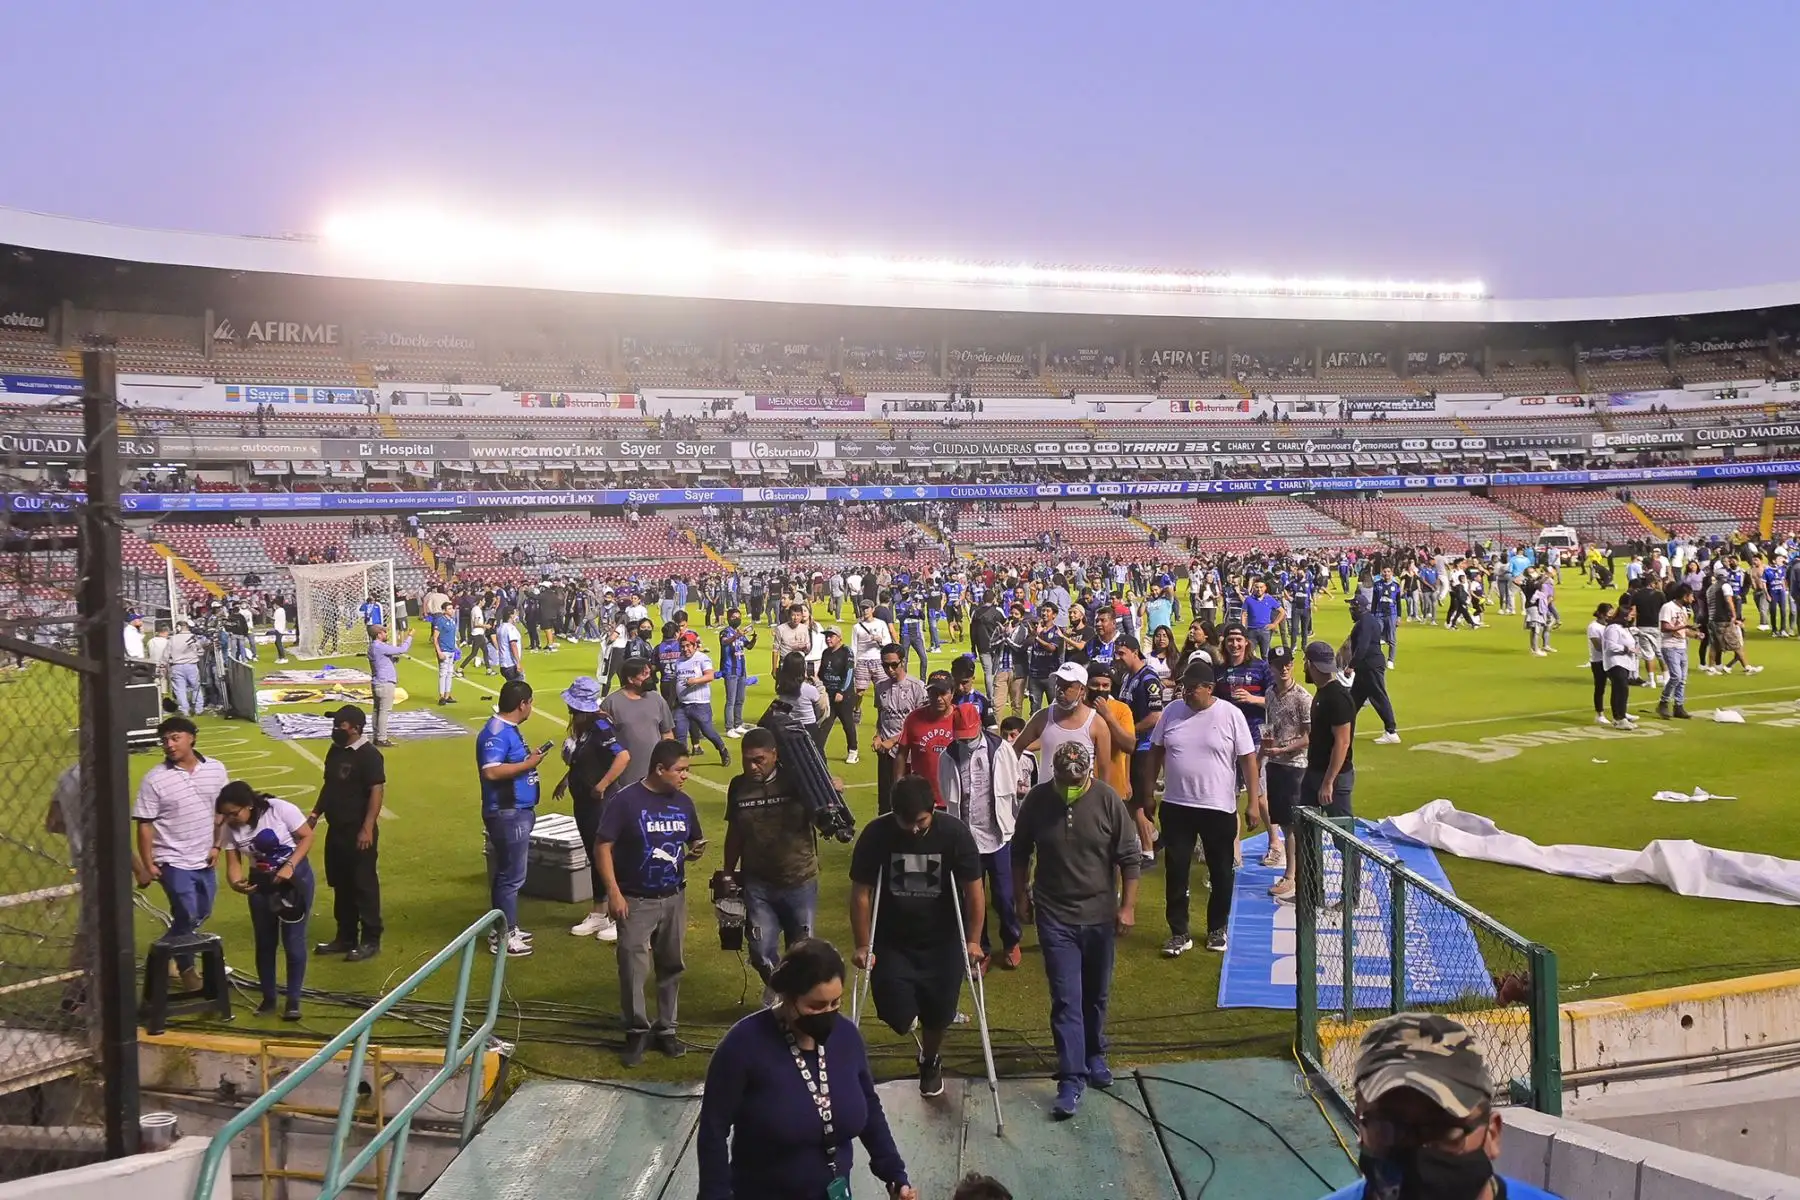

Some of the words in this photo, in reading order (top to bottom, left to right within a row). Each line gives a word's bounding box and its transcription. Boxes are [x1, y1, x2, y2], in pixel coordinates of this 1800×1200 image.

[248, 321, 338, 343] AFIRME
[249, 389, 286, 402] Sayer
[316, 389, 351, 403] Syer
[1607, 432, 1684, 446] caliente.mx
[1697, 429, 1747, 440] CIUDAD
[0, 435, 71, 453] CIUDAD
[1227, 441, 1255, 450] CHARLY
[1277, 441, 1304, 450] CHARLY
[1496, 438, 1515, 446] Los
[1520, 436, 1577, 446] Laureles
[380, 444, 434, 458] Hospital
[758, 442, 811, 457] asturiano
[933, 442, 978, 454] CIUDAD
[981, 442, 1031, 454] MADERAS
[1123, 442, 1180, 452] TARRO
[1597, 471, 1641, 480] caliente.mx
[1651, 469, 1697, 478] caliente.mx
[1714, 466, 1754, 475] CIUDAD
[1525, 472, 1583, 482] Laureles
[1127, 482, 1181, 493] TARRO
[1229, 481, 1257, 490] CHARLY
[1279, 480, 1306, 489] CHARLY
[761, 487, 804, 501] asturiano
[951, 486, 987, 497] CIUDAD
[990, 486, 1028, 496] MADERAS
[646, 820, 686, 832] GALLOS
